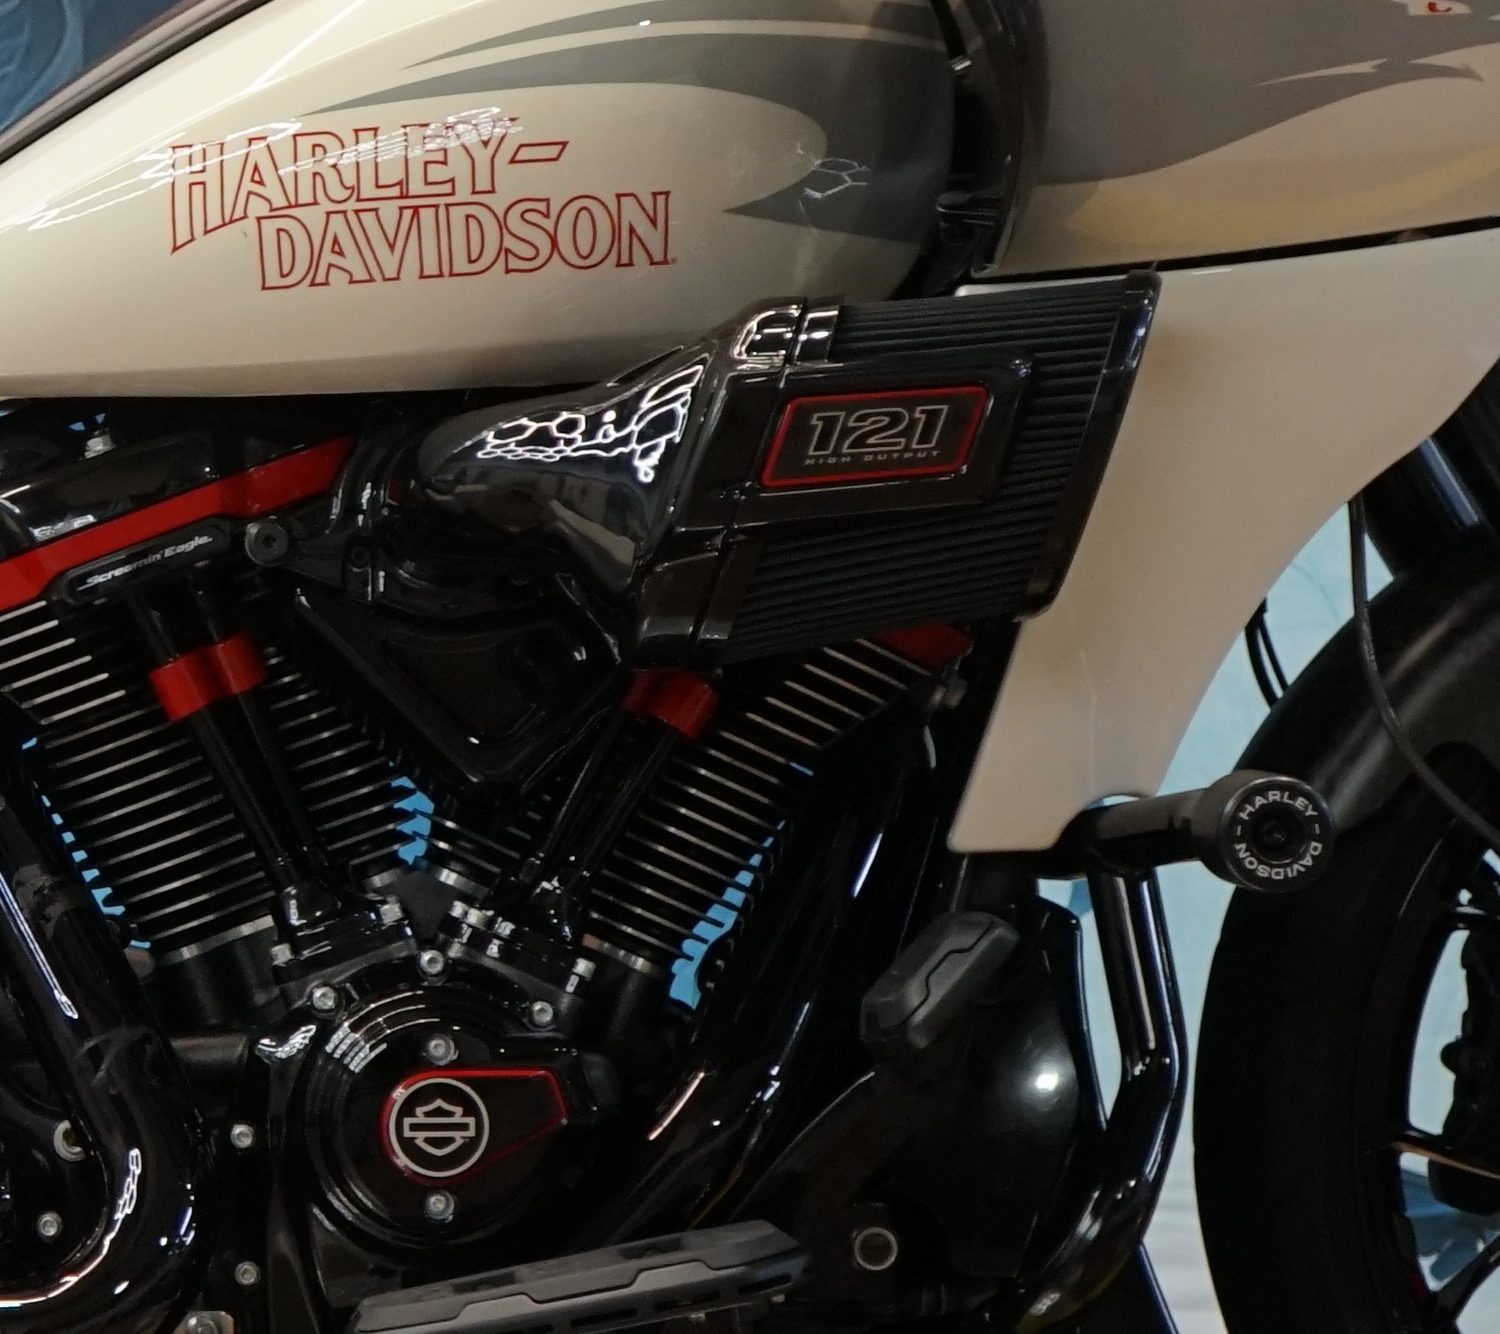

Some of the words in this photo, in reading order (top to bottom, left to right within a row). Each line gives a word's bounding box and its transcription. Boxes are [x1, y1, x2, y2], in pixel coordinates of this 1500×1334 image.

[255, 189, 674, 292] DAVIDSON
[807, 404, 950, 456] 121
[863, 450, 941, 462] OUTPUT
